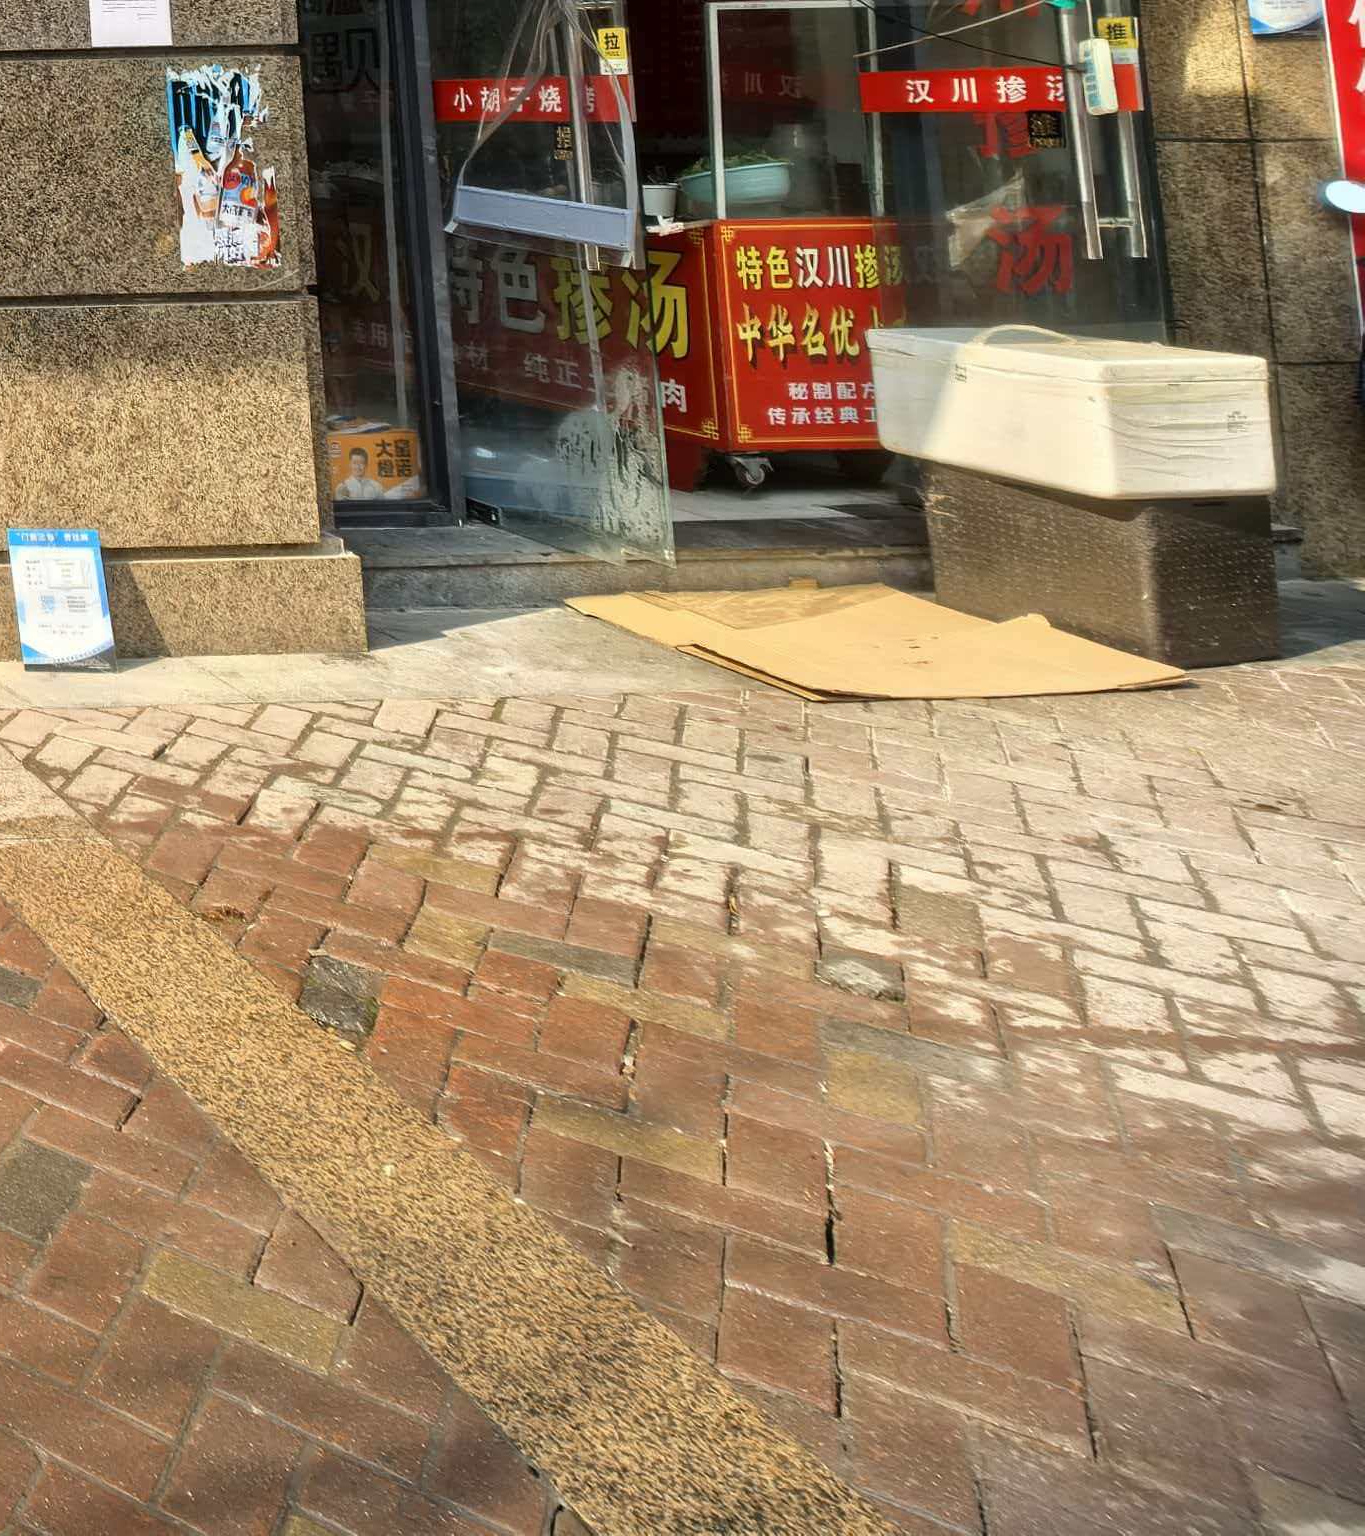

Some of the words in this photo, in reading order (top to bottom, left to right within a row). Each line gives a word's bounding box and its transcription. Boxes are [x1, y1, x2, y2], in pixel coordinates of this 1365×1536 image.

[603, 31, 621, 51] 拉
[736, 302, 907, 364] 中华名优
